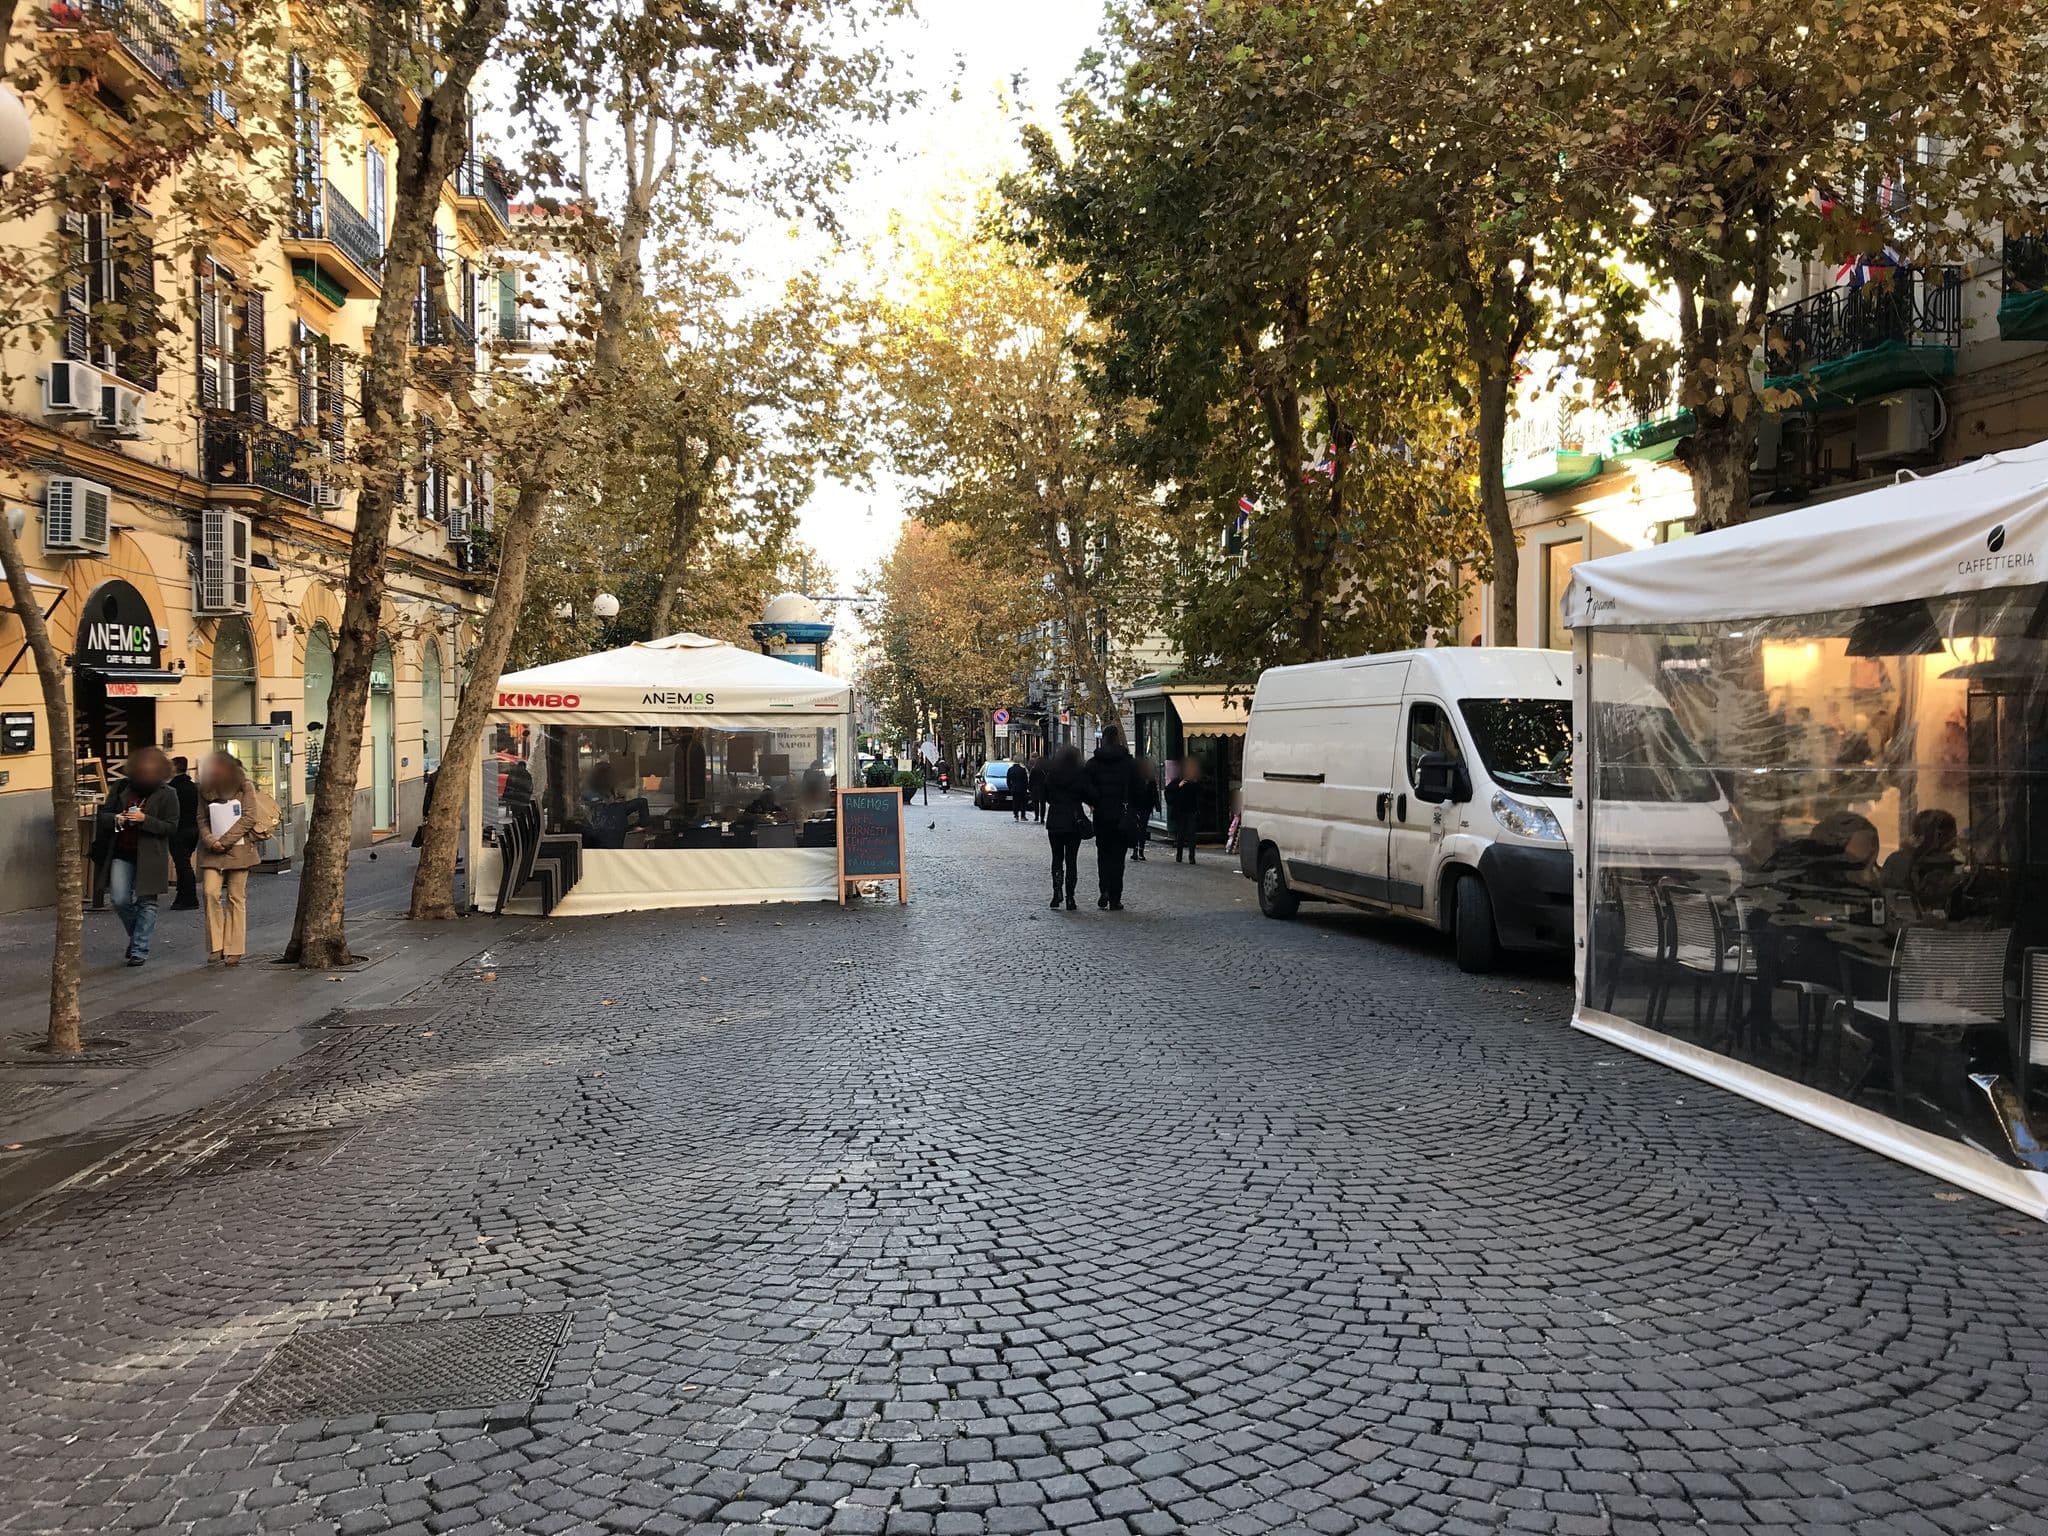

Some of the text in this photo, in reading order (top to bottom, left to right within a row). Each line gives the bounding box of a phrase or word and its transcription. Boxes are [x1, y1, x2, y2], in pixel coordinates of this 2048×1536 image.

[1958, 552, 2035, 575] CAFFETTERIA
[87, 623, 151, 652] ANEMOS
[498, 693, 581, 708] KIMBO
[642, 692, 714, 705] ANEMOS
[778, 741, 811, 749] NAPOLI
[845, 796, 889, 811] ANEMOS
